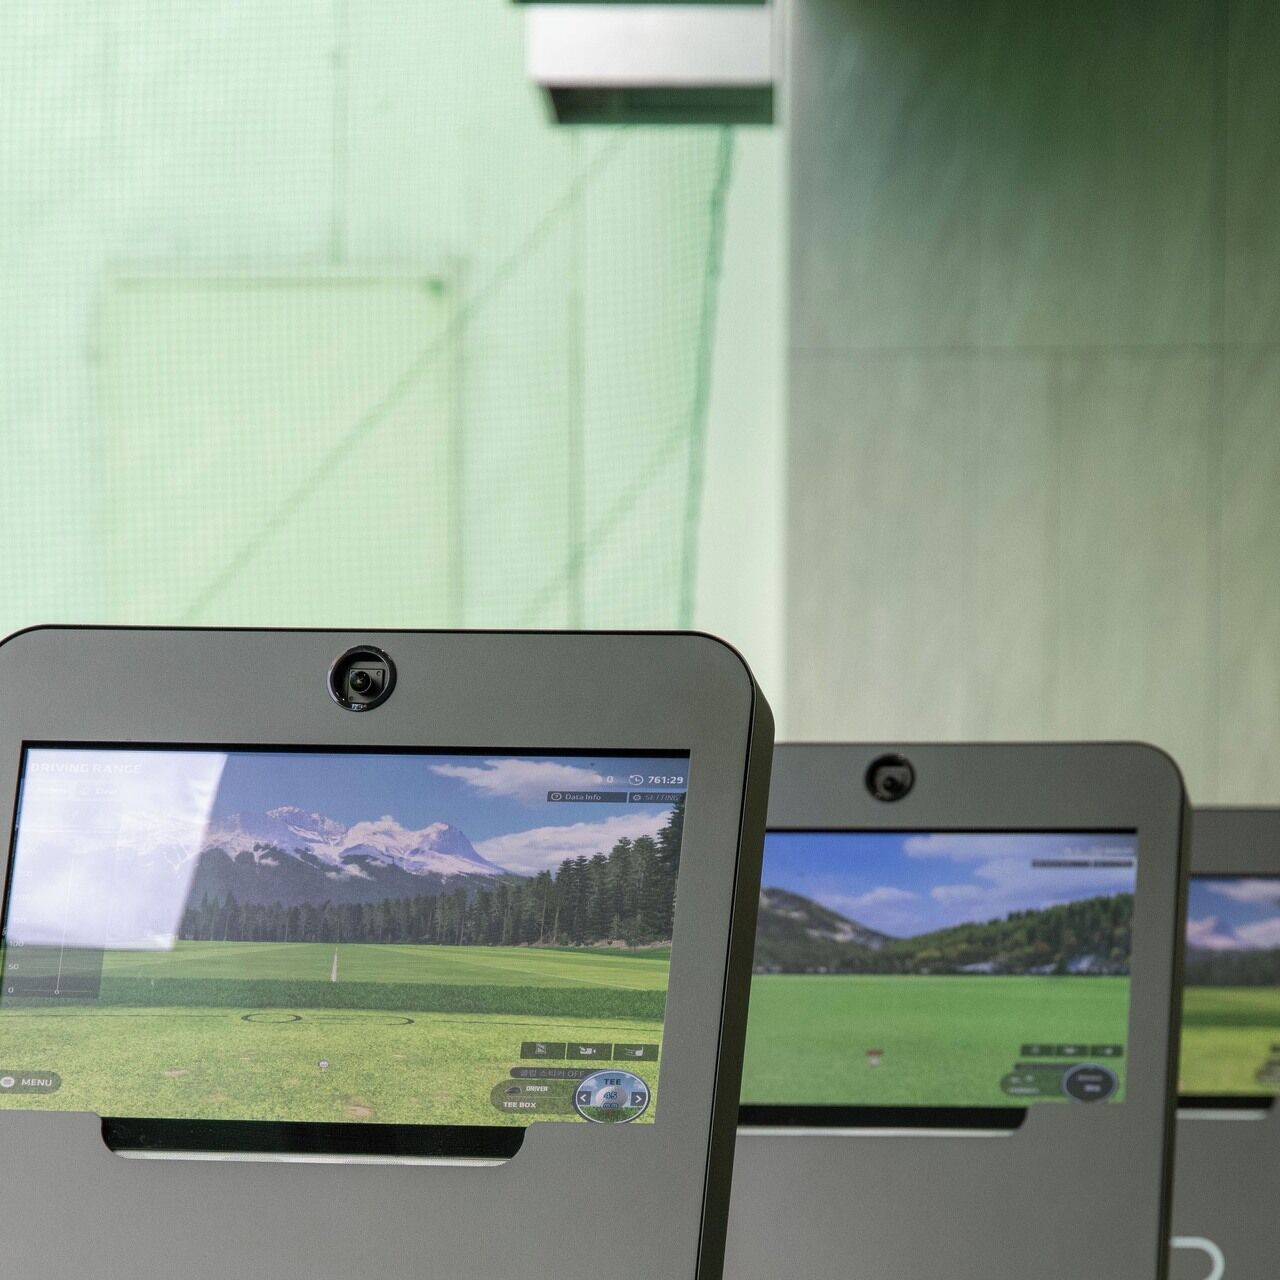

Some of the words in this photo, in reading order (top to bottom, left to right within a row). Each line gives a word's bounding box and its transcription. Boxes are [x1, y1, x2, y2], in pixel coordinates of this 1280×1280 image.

[30, 762, 89, 773] DRIVING
[92, 763, 143, 774] RANGE
[606, 775, 614, 784] 0
[648, 775, 684, 784] 761:29
[565, 793, 584, 801] Data
[585, 793, 602, 801] Info
[8, 962, 20, 970] 50
[7, 986, 15, 994] 0
[567, 1070, 585, 1078] OFF
[21, 1078, 53, 1087] MENU
[604, 1078, 622, 1086] TEE
[519, 1101, 537, 1109] BOX
